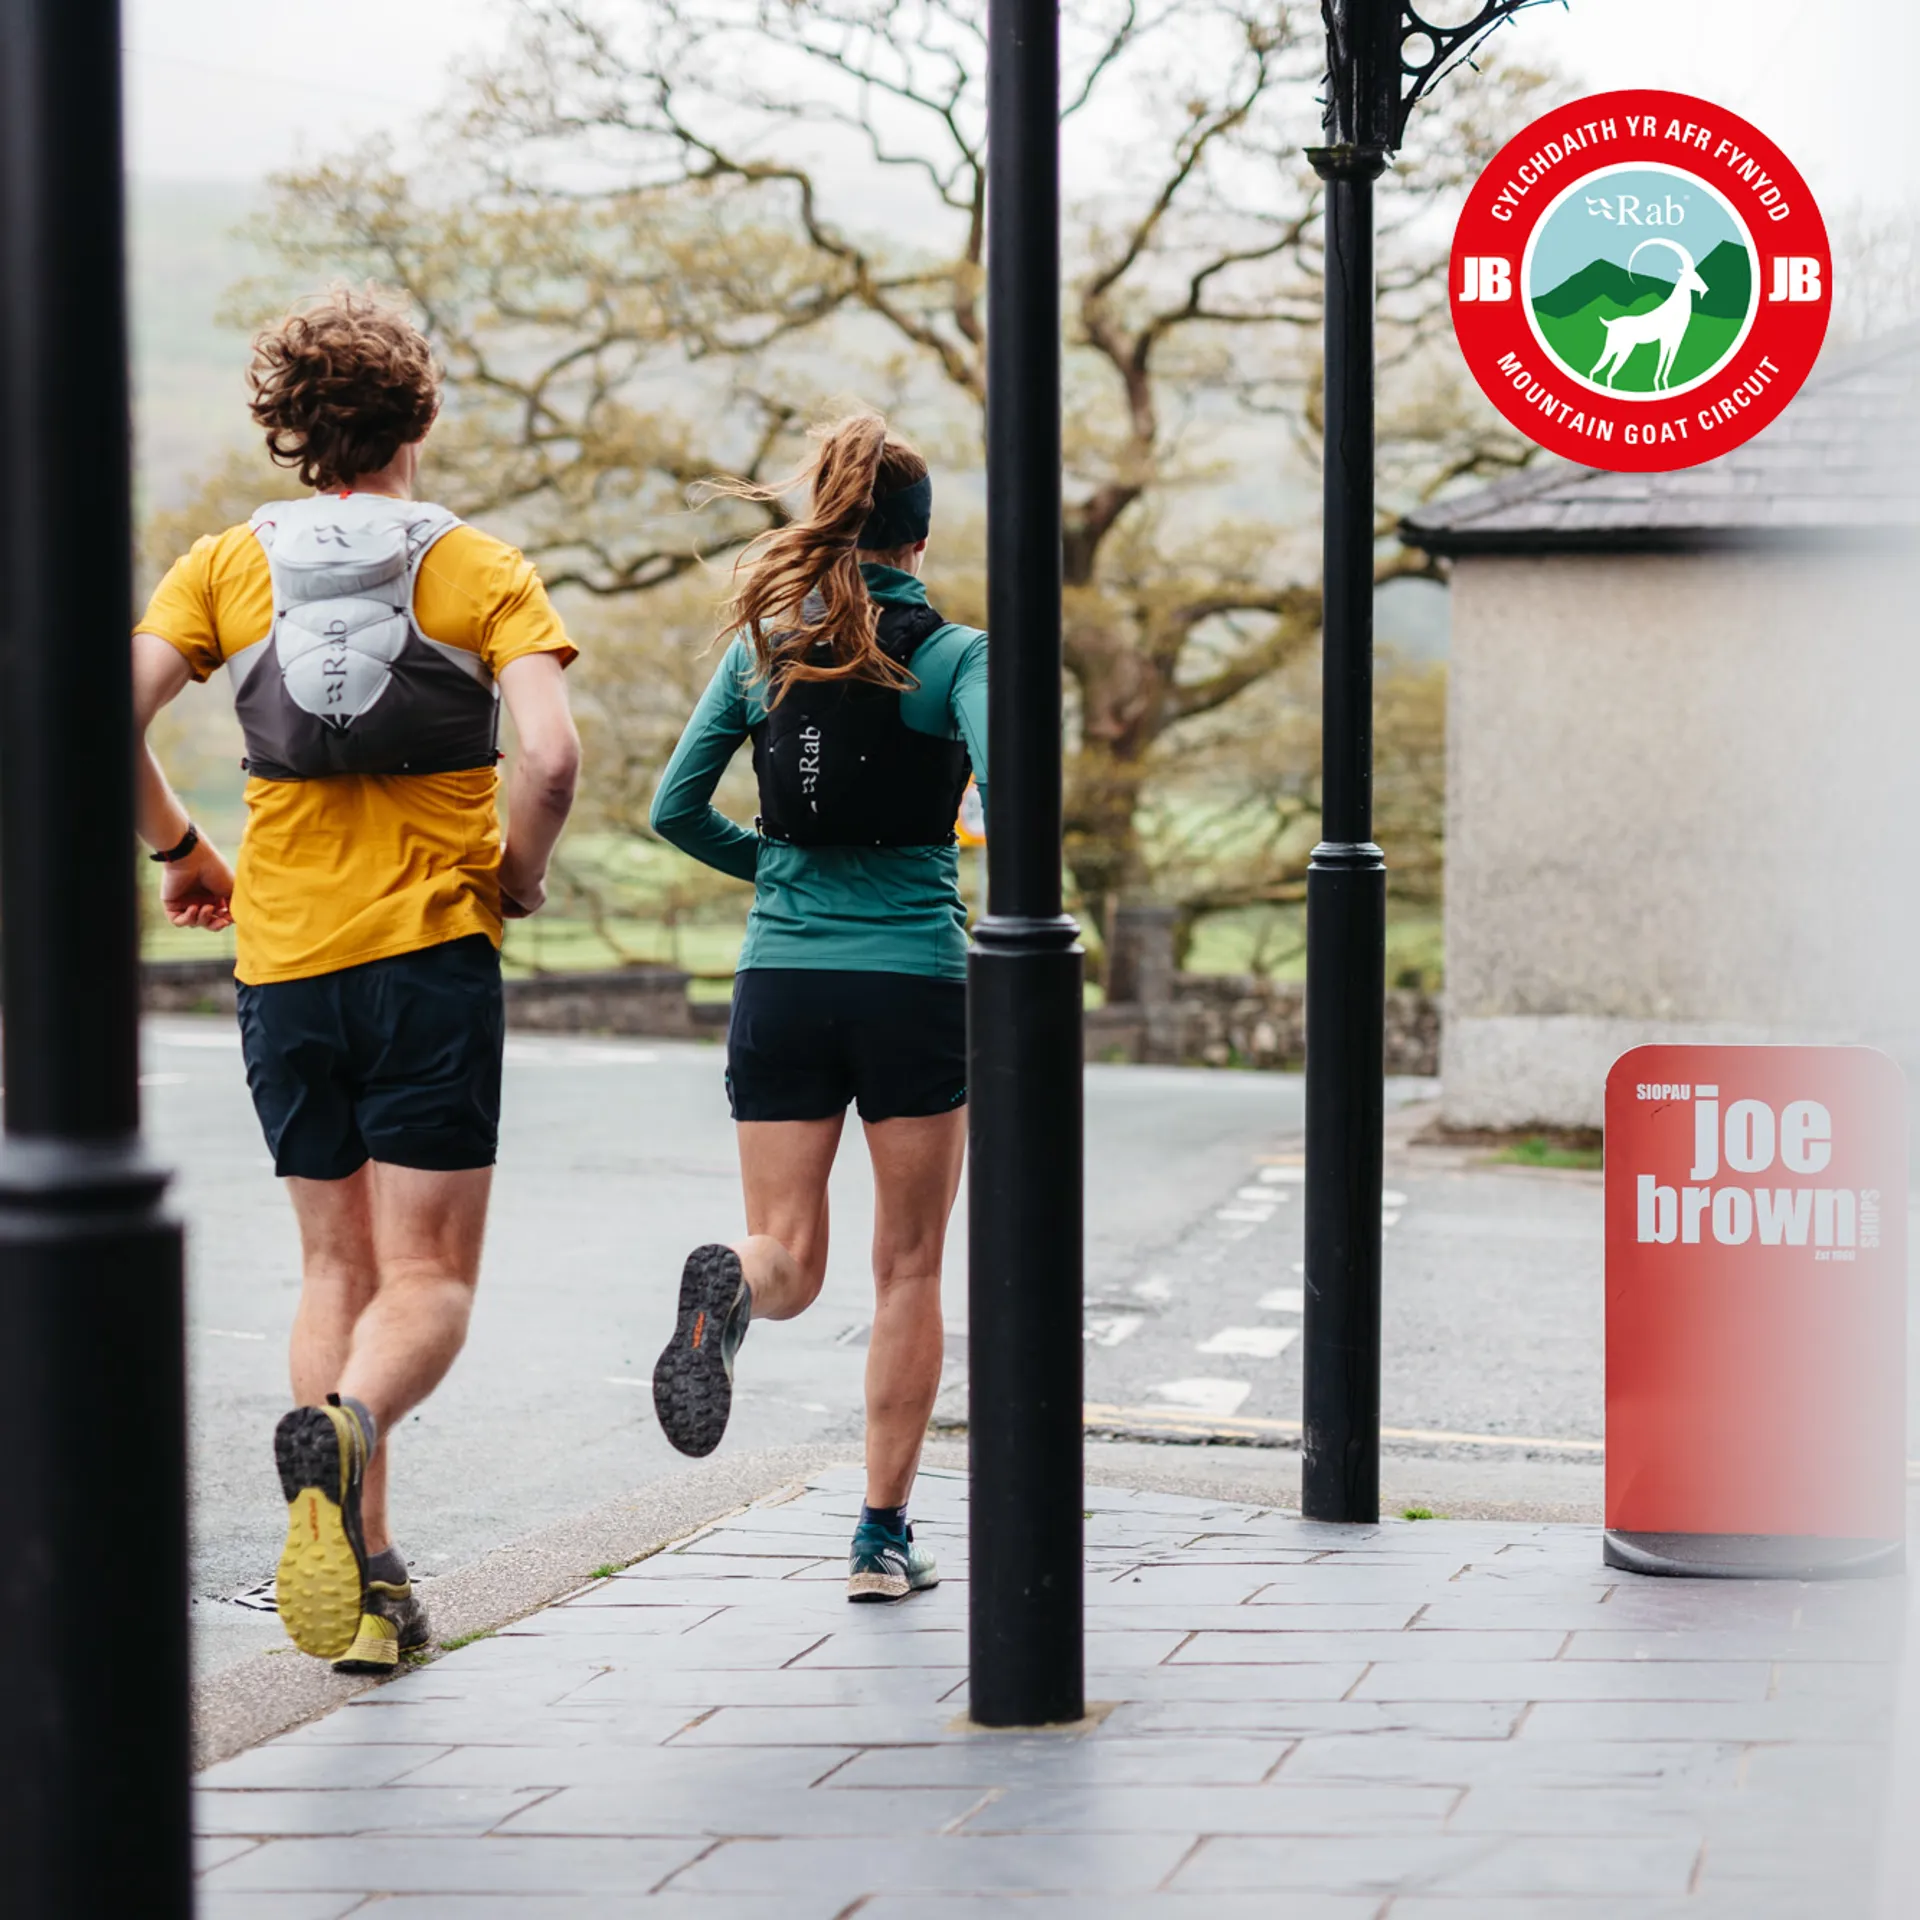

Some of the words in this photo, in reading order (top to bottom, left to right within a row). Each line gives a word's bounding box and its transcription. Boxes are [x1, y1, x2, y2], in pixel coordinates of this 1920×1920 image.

[323, 619, 348, 677] Rab
[799, 725, 822, 775] Rab
[1636, 1084, 1691, 1100] SIOPAU
[1690, 1084, 1832, 1181] joe
[1636, 1174, 1856, 1247] brown
[1859, 1188, 1881, 1249] SHOPS
